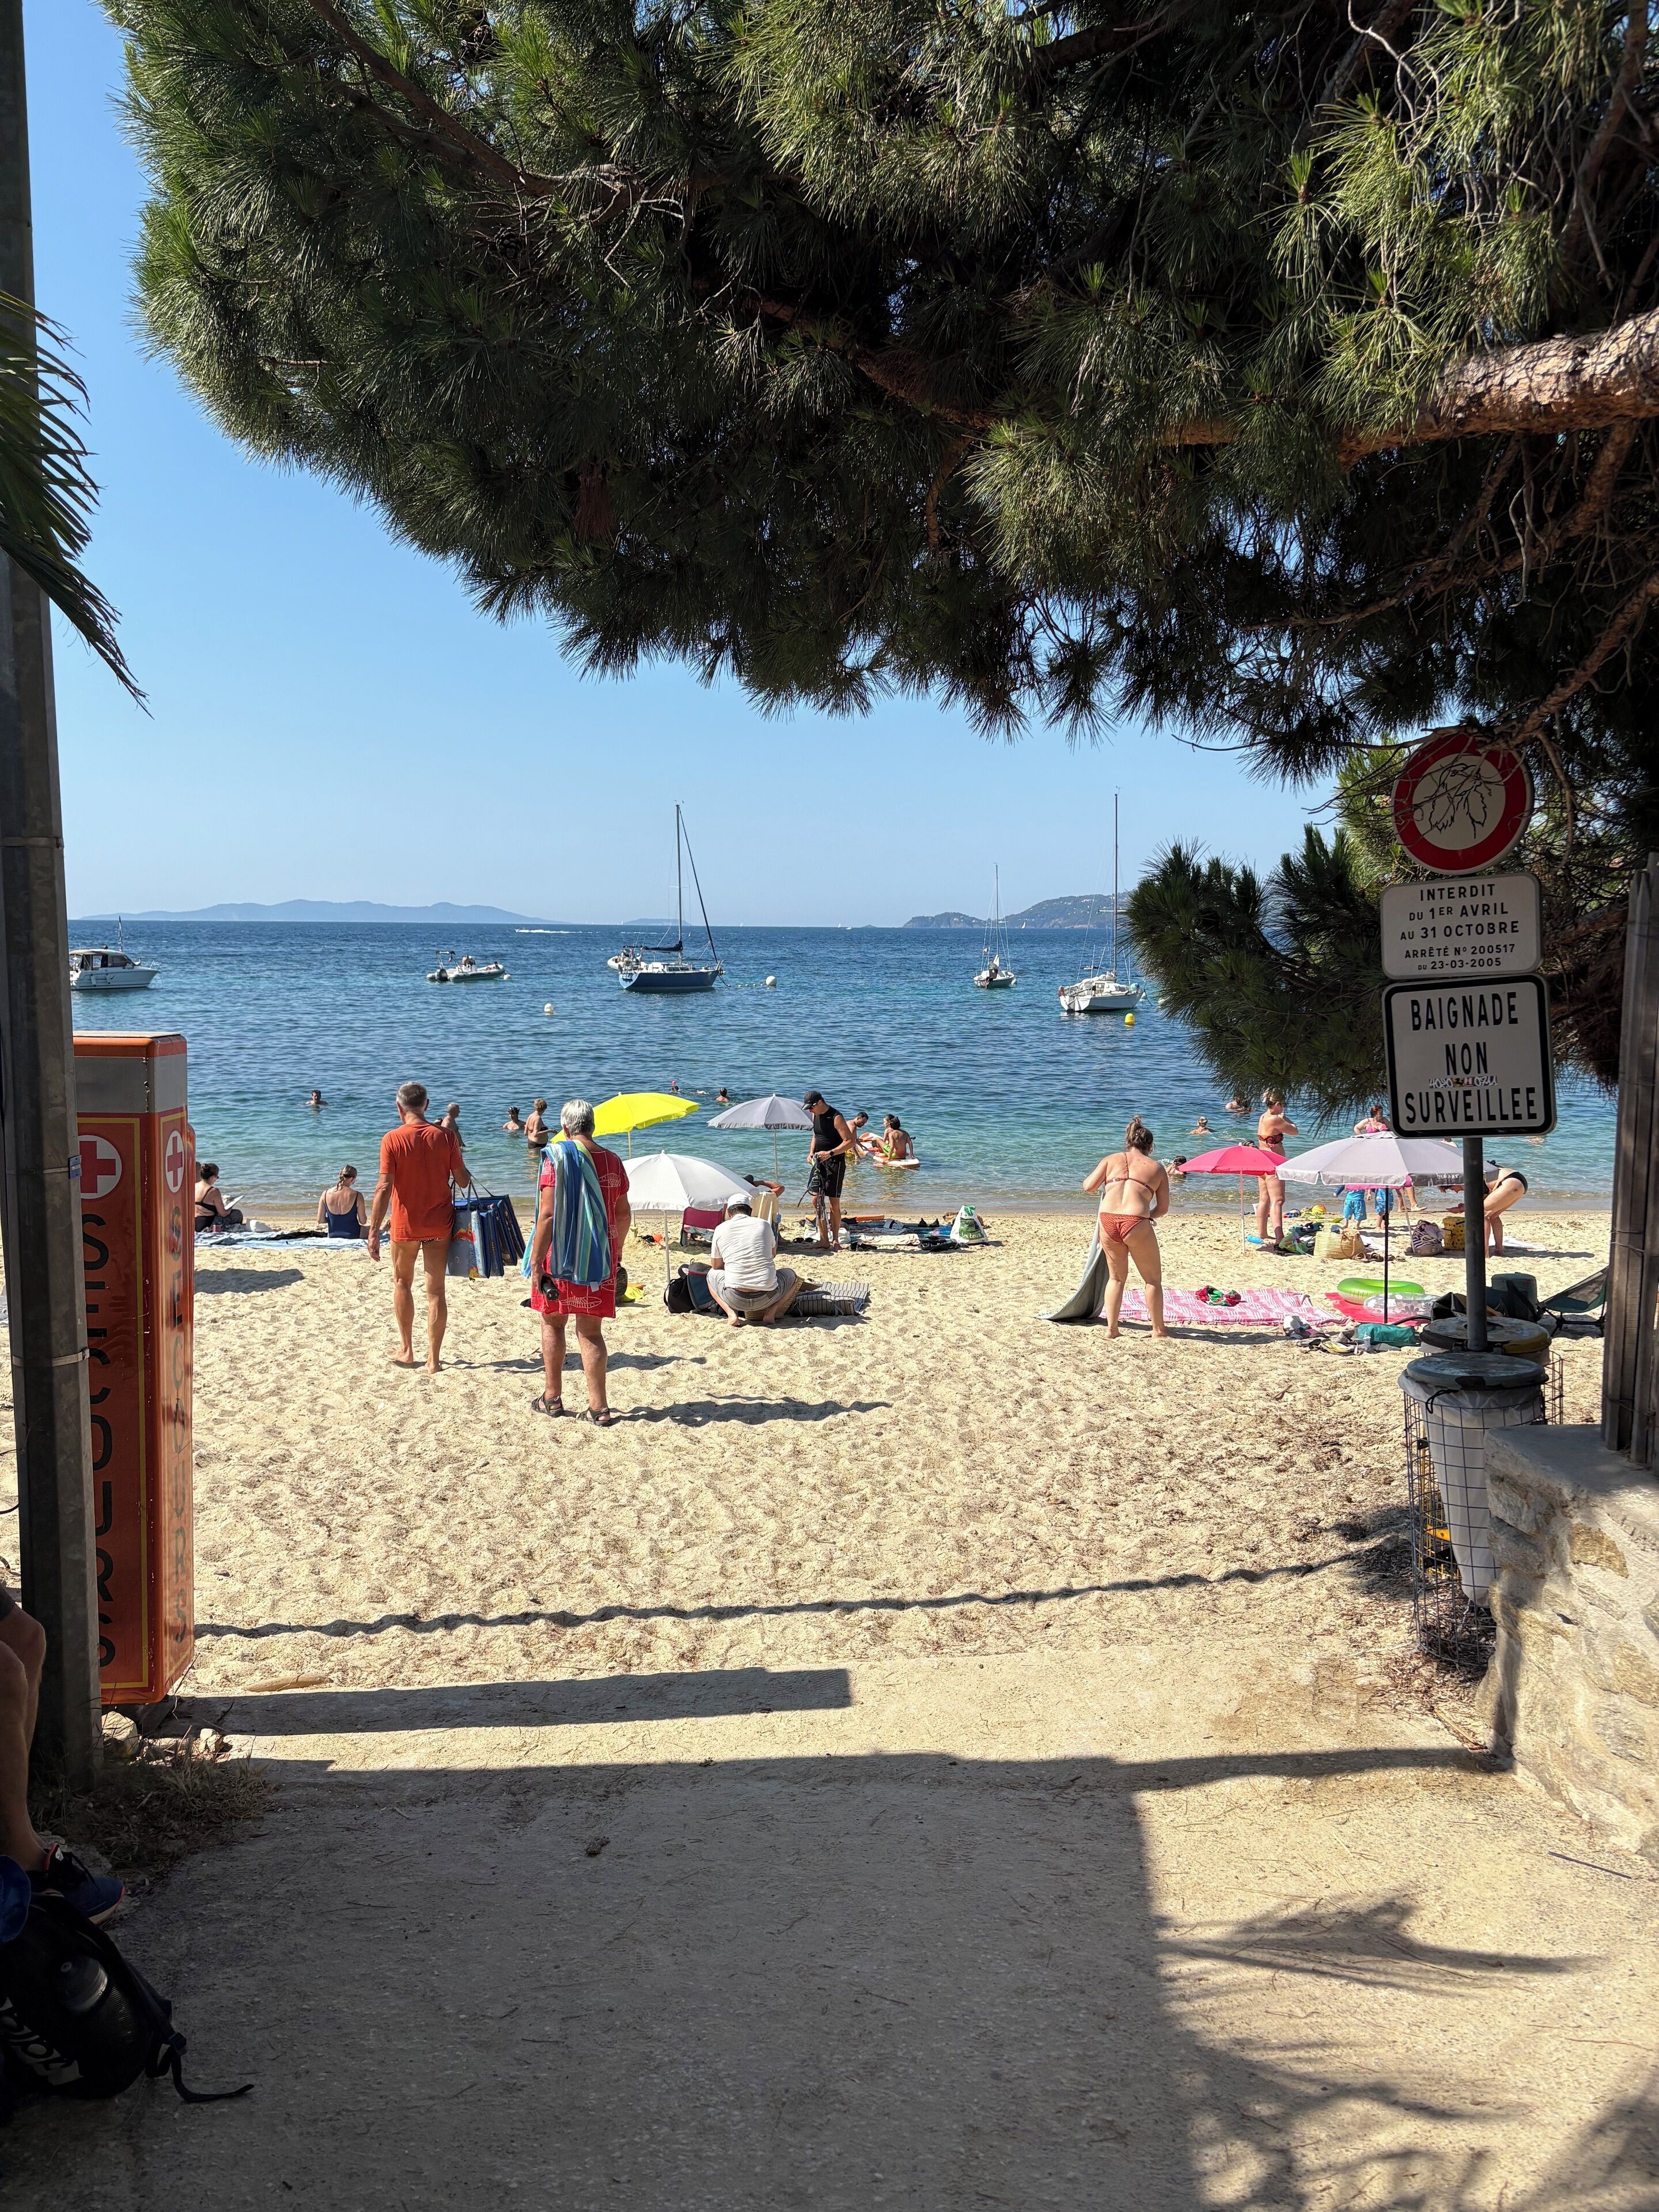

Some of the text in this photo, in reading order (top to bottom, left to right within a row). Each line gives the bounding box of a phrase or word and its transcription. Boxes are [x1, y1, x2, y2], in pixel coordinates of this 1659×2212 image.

[1420, 884, 1495, 902] INTERDIT
[1409, 911, 1423, 921] DU
[1460, 902, 1509, 918] AVRIL
[1400, 921, 1519, 941] AU 31 OCTOBRE
[1471, 944, 1515, 955] 200517
[1430, 957, 1501, 970] 23-03-2005
[1410, 991, 1518, 1031] BAIGNADE
[1445, 1041, 1488, 1075] NON
[1405, 1086, 1537, 1124] SURVEILLEE
[171, 1206, 186, 1643] SECOURS
